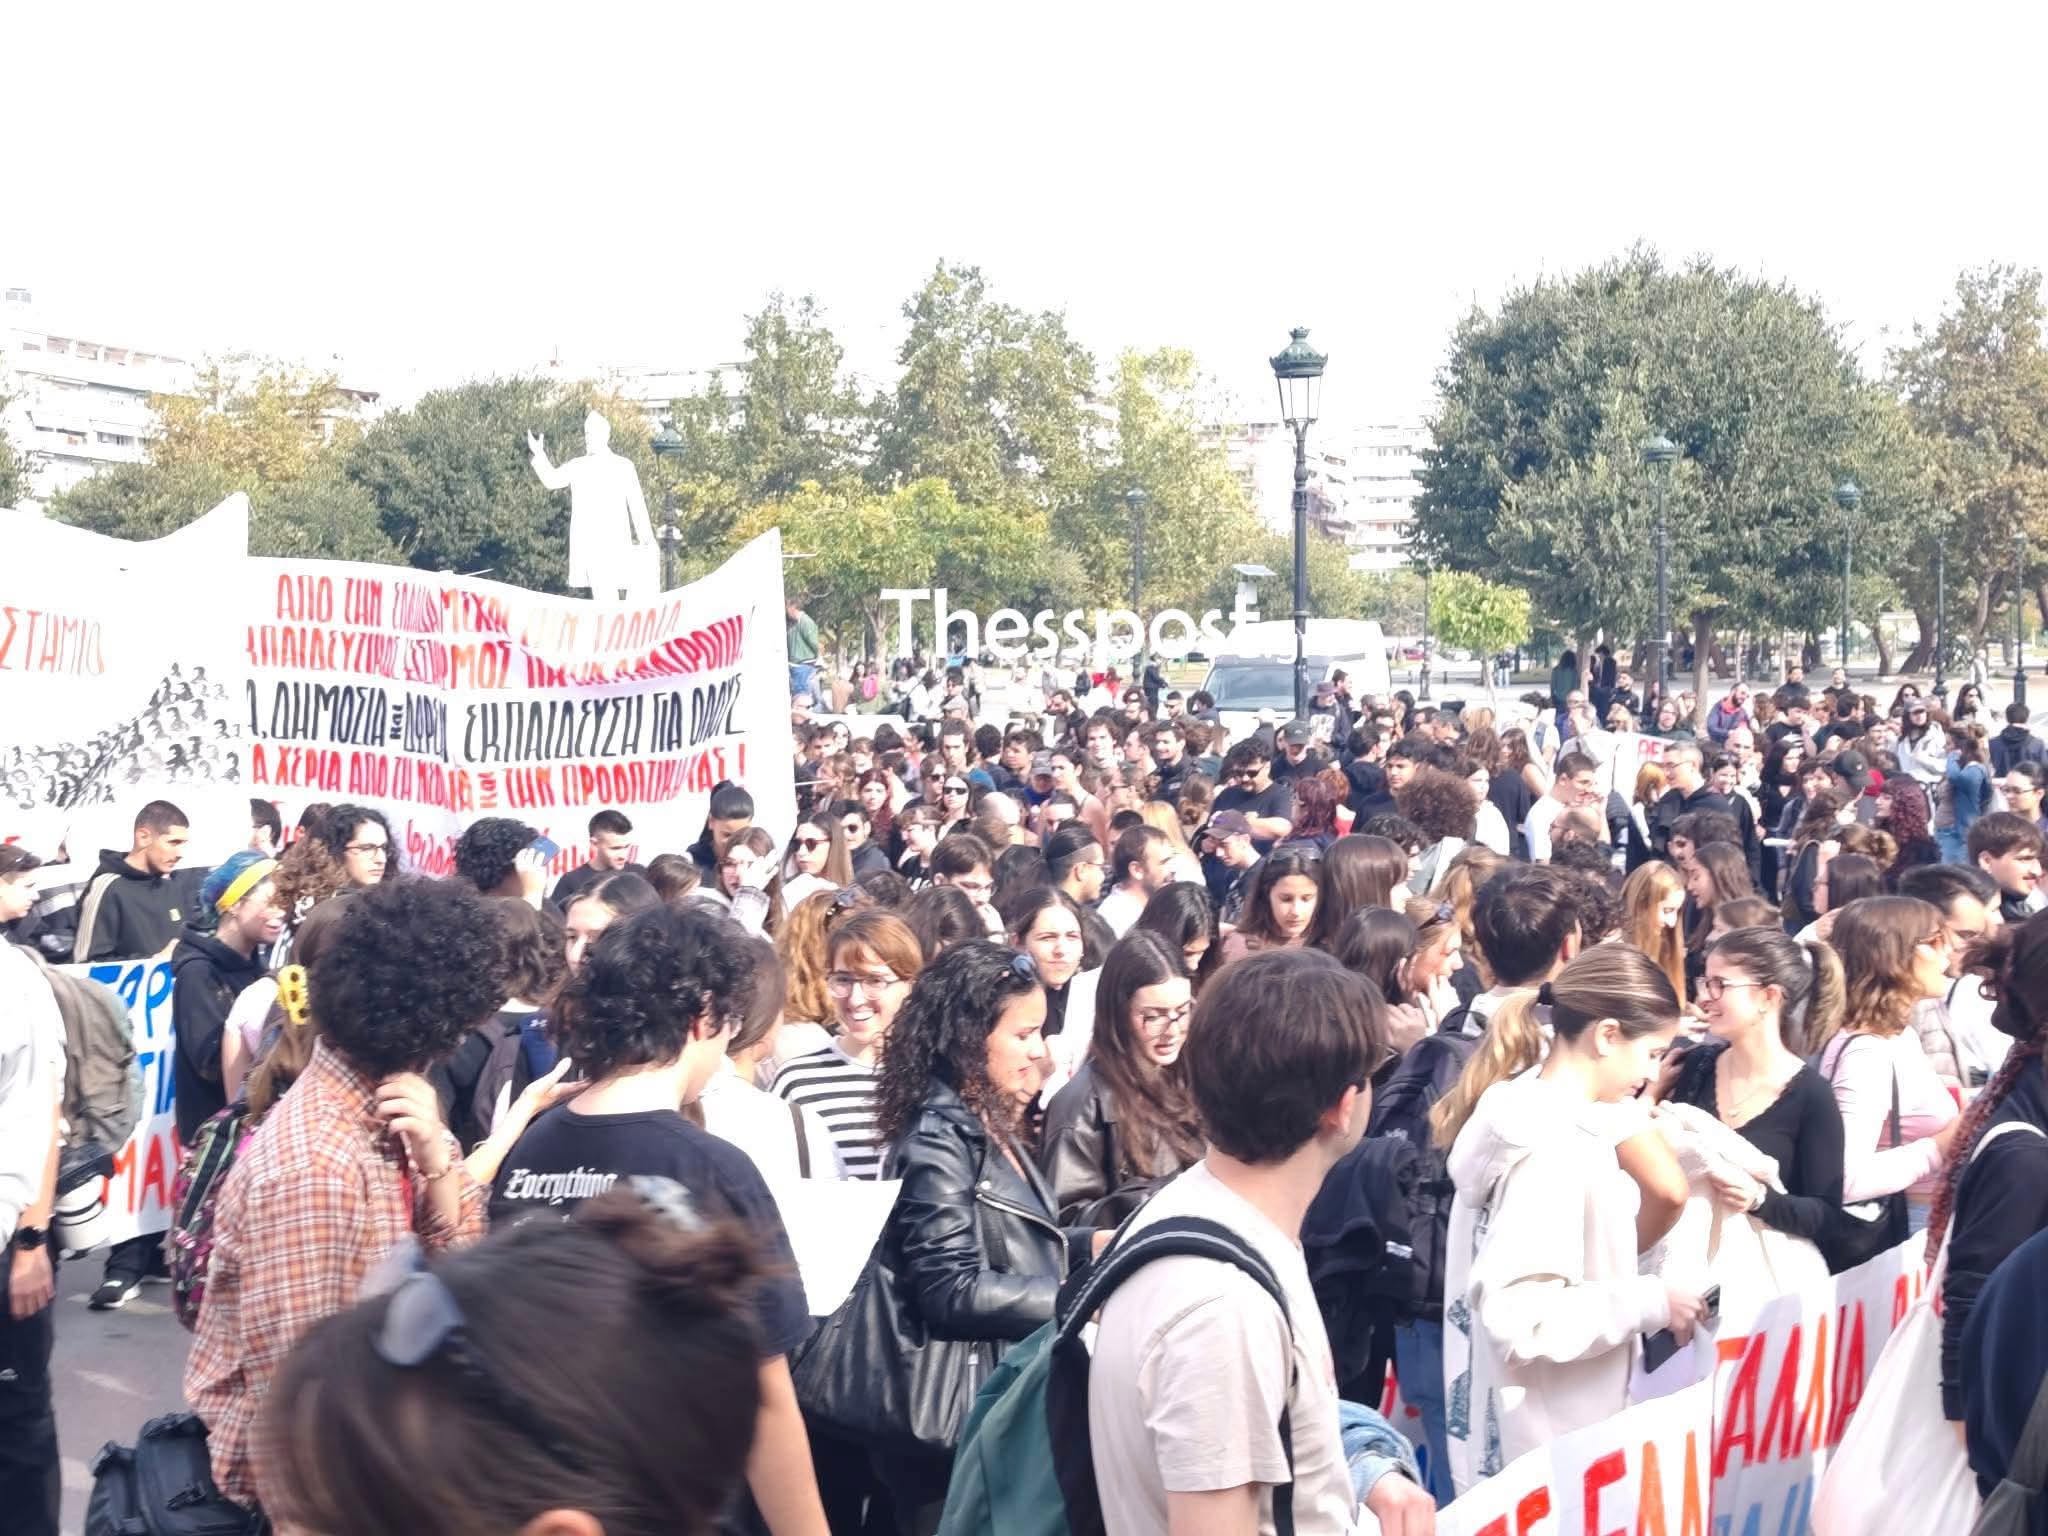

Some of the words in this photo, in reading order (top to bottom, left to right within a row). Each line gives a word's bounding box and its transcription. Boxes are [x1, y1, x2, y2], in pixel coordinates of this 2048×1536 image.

[276, 574, 333, 623] ΑΠΟ
[271, 680, 388, 748] ΔΗΜΟΣΙΑ
[464, 694, 645, 764] ΕΚΠΑΙΔΕΥΣΗ
[650, 691, 683, 754] ΓΙΑ
[275, 746, 342, 793] ΧΕΡΙΑ
[348, 750, 388, 799] ΑΠΟ
[505, 767, 556, 809] ΤΗΝ
